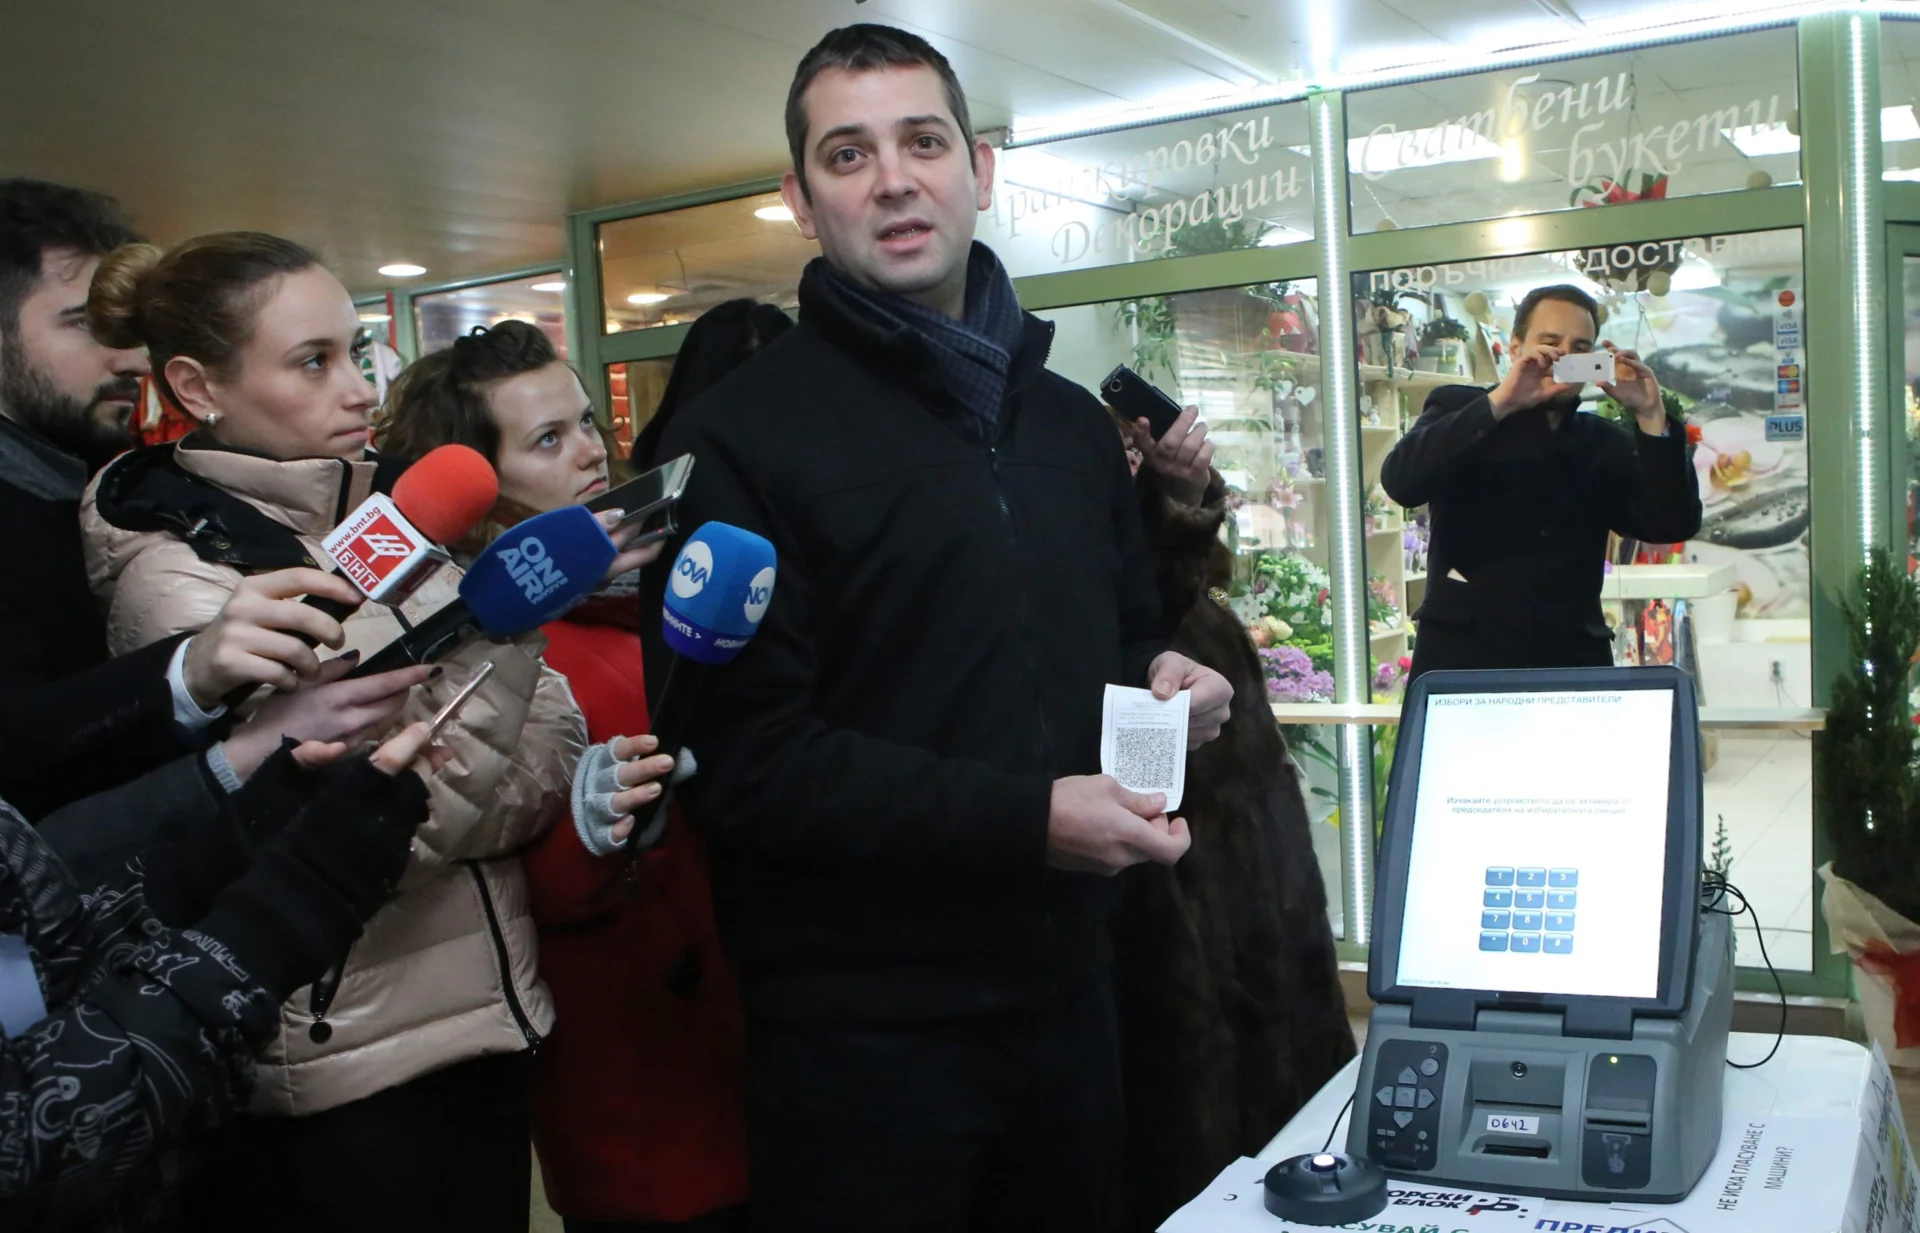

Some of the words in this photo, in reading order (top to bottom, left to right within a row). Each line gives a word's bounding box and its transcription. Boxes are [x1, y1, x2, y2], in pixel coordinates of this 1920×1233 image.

[1359, 71, 1632, 182] Сватбени
[1567, 94, 1785, 199] букети
[1051, 165, 1301, 265] Декорации
[1779, 321, 1798, 330] VISA
[1779, 336, 1798, 344] VISA
[1768, 421, 1802, 433] PLUS
[328, 505, 382, 555] www.bnt.bg
[519, 536, 564, 587] ON
[337, 551, 377, 589] БНТ
[496, 547, 544, 603] AIR
[1435, 698, 1472, 707] ИЗБОРИ
[1474, 697, 1486, 706] ЗА
[1488, 697, 1535, 706] НАРОДНИ
[1537, 695, 1621, 705] ПРЕДСТАВИТЕЛИ
[1527, 872, 1534, 880] 2
[1560, 873, 1566, 881] 3
[1526, 894, 1532, 902] 5
[1558, 894, 1564, 902] 6
[1524, 915, 1530, 923] 8
[1556, 916, 1563, 924] 9
[1522, 937, 1528, 946] 0
[1491, 1118, 1530, 1131] 0642
[1731, 1129, 1763, 1175] ГЛАСУВАНЕ
[1763, 1146, 1794, 1190] МАШИНИ?
[1721, 1176, 1747, 1197] ИСКА
[1387, 1189, 1473, 1202] ОРСКИ
[1392, 1198, 1465, 1209] БЛОК
[1716, 1198, 1738, 1211] НЕ
